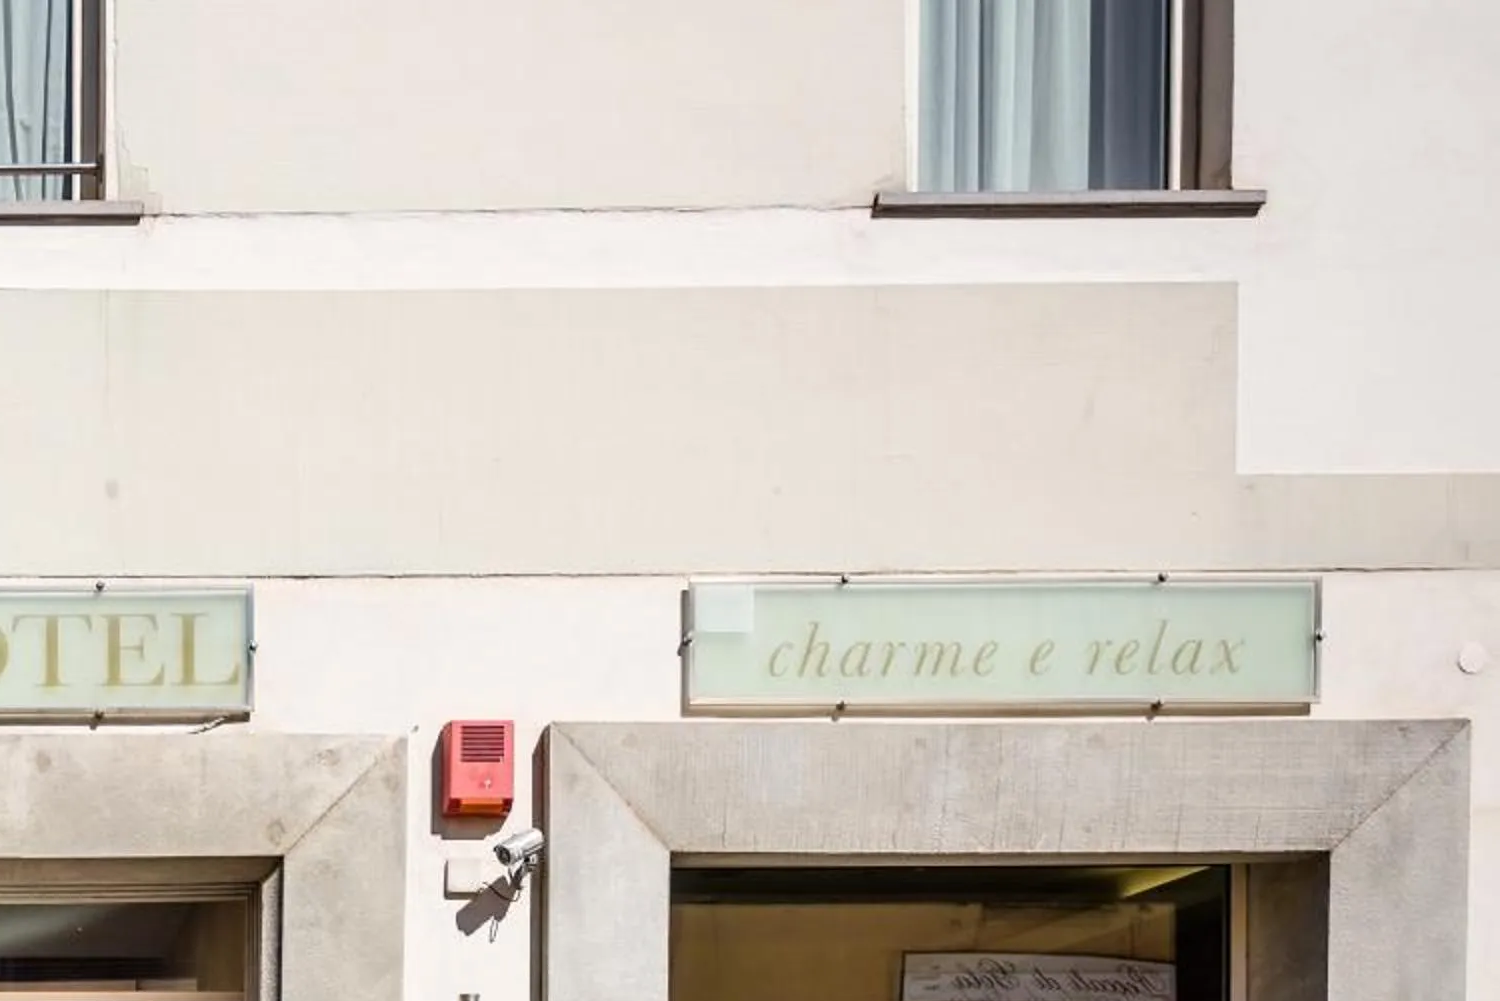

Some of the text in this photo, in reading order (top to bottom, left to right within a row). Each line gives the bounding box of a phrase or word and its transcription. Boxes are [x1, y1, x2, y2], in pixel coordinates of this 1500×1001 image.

[766, 618, 1247, 679] charme e relax
